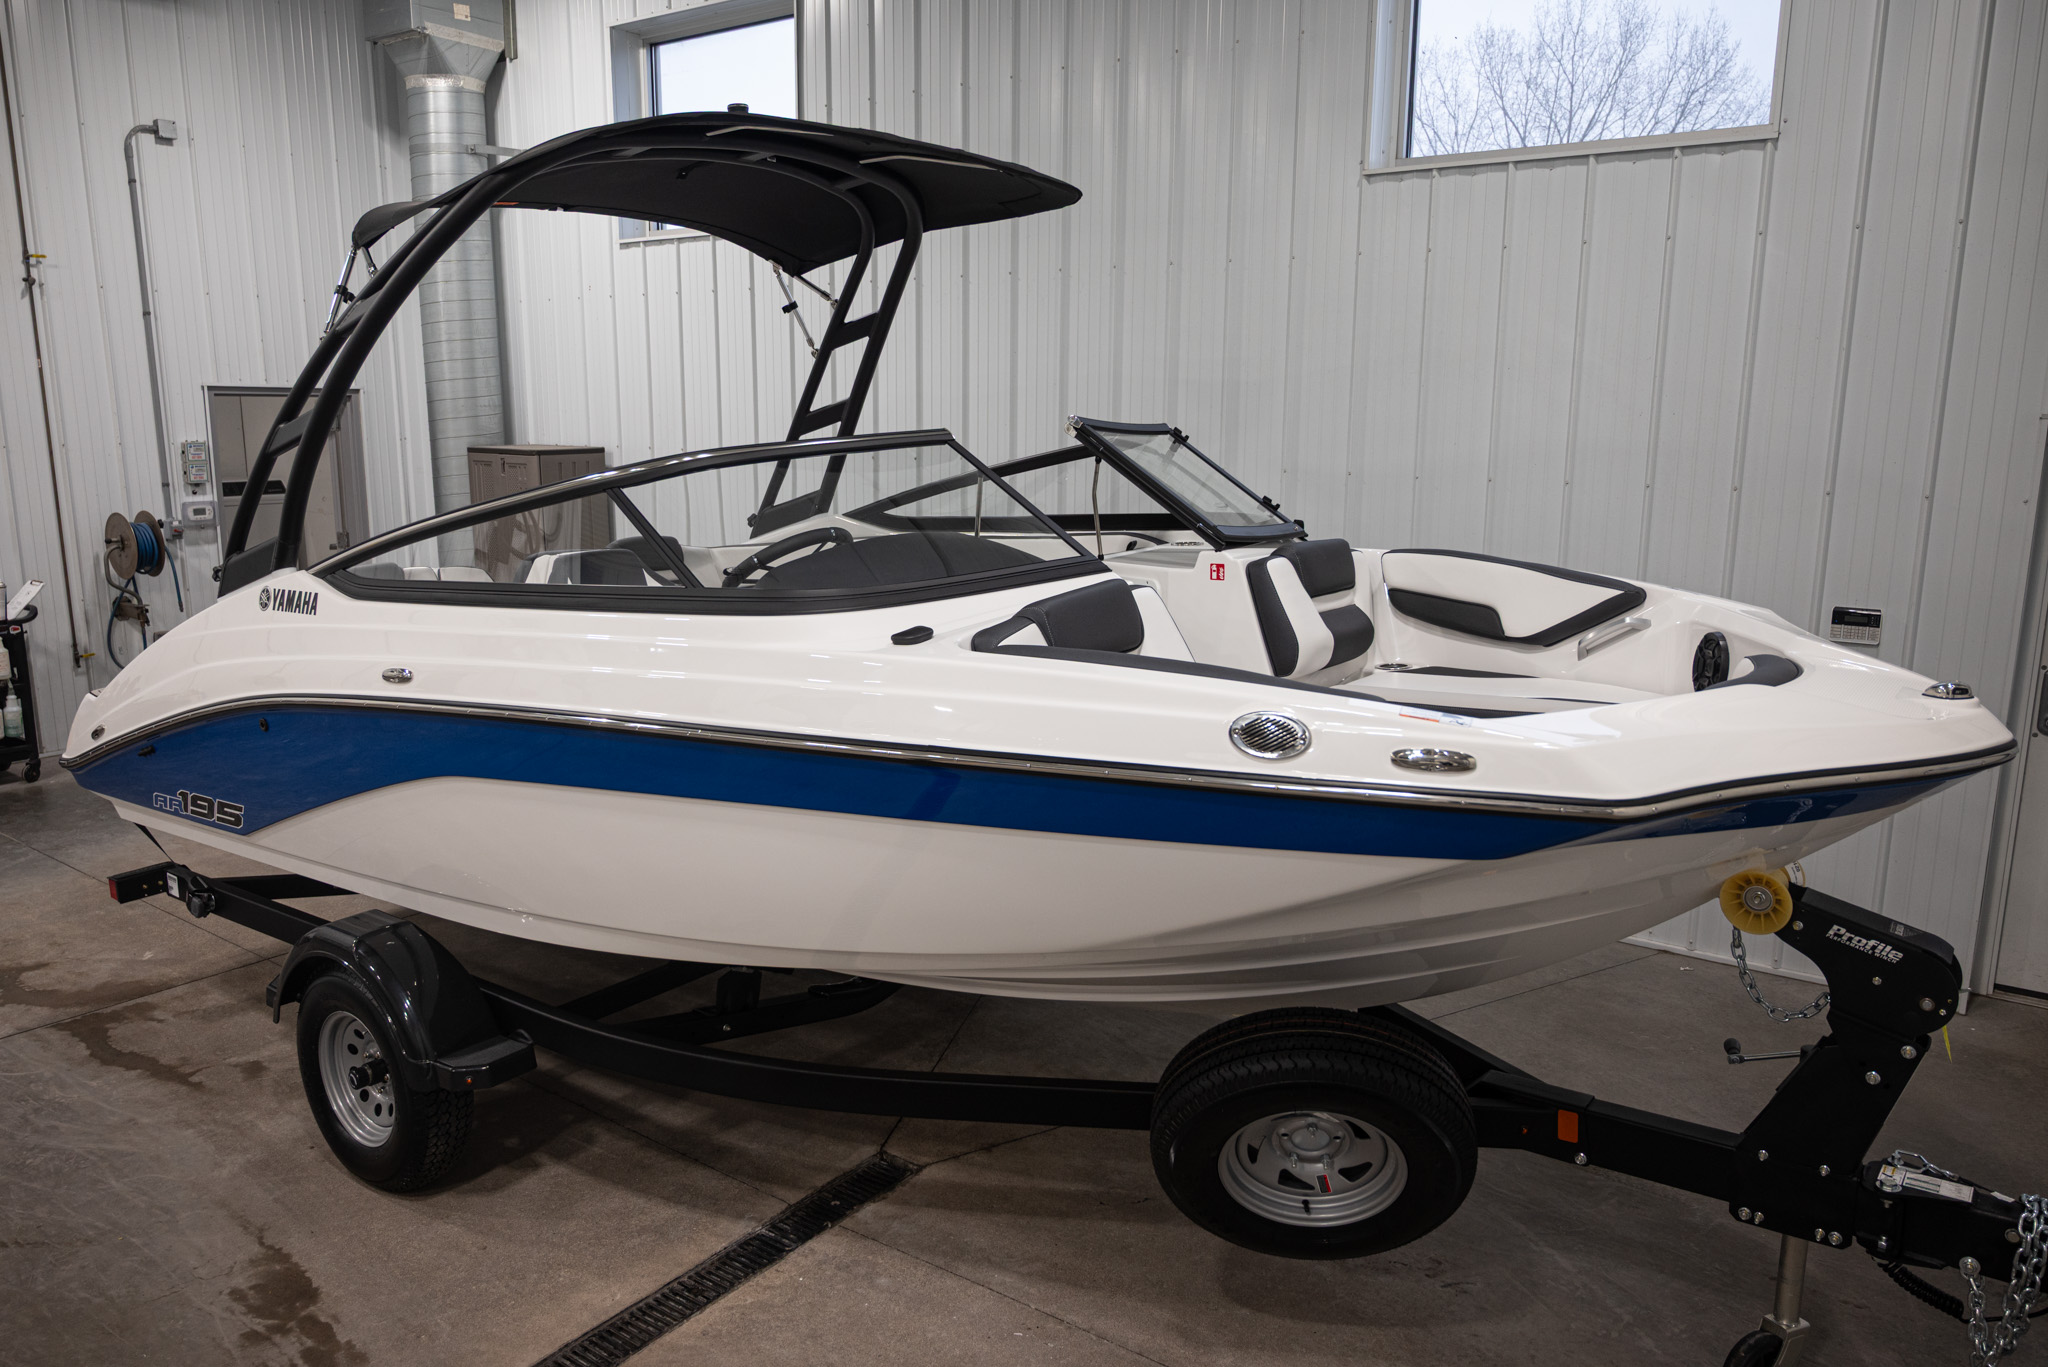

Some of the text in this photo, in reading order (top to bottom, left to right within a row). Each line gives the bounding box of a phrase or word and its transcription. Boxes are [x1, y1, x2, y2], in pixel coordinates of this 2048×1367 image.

[272, 588, 319, 616] YAMAHA
[1826, 933, 1897, 964] PERFORMANCE WINCH
[1827, 924, 1904, 961] Profile
